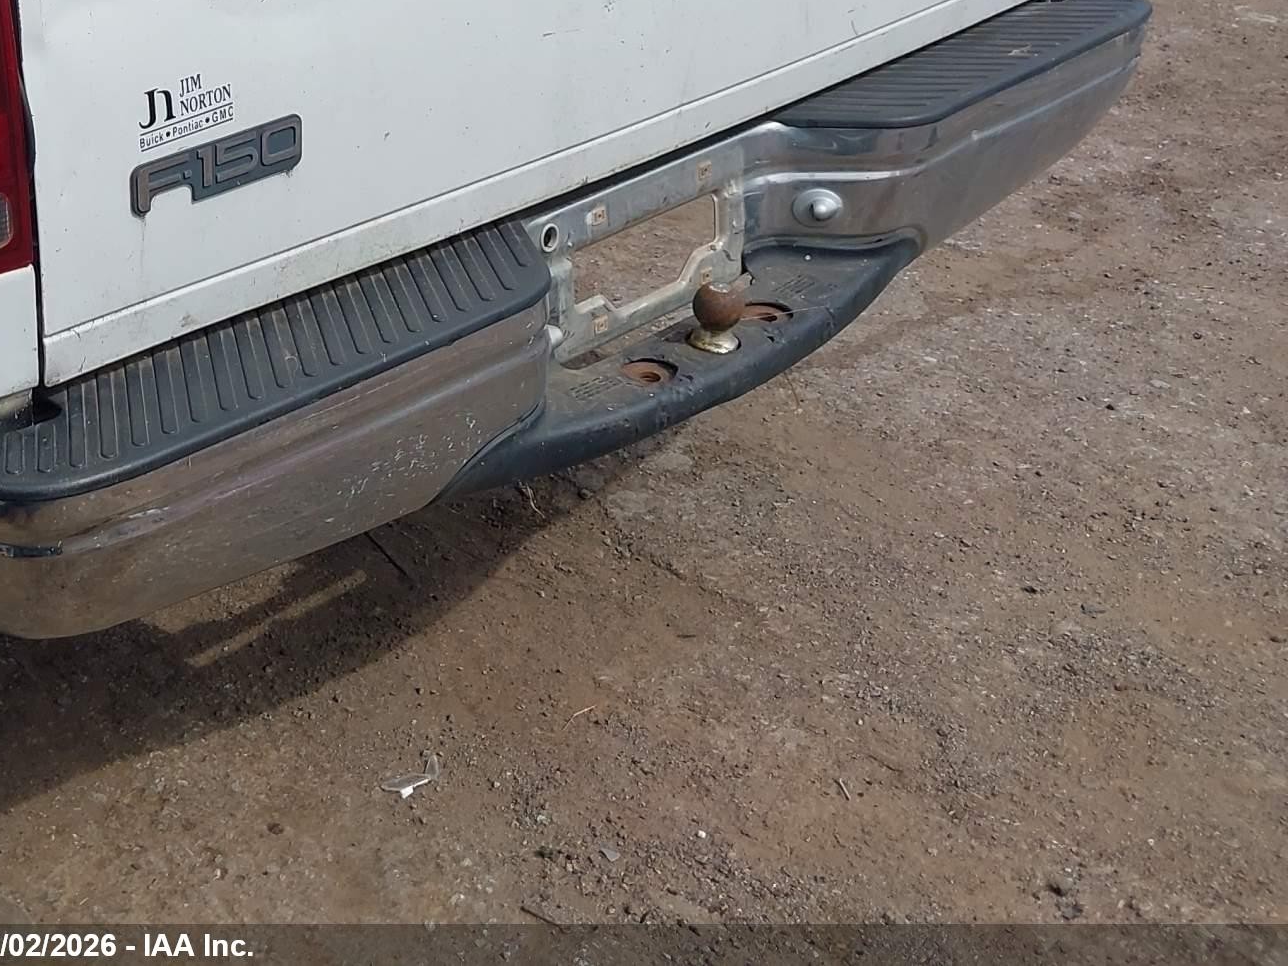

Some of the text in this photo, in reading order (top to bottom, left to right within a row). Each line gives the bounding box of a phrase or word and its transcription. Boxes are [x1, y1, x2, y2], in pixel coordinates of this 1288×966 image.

[179, 73, 203, 98] JIM
[179, 84, 232, 117] NORTON
[139, 105, 234, 149] Buick Pontiac GMC
